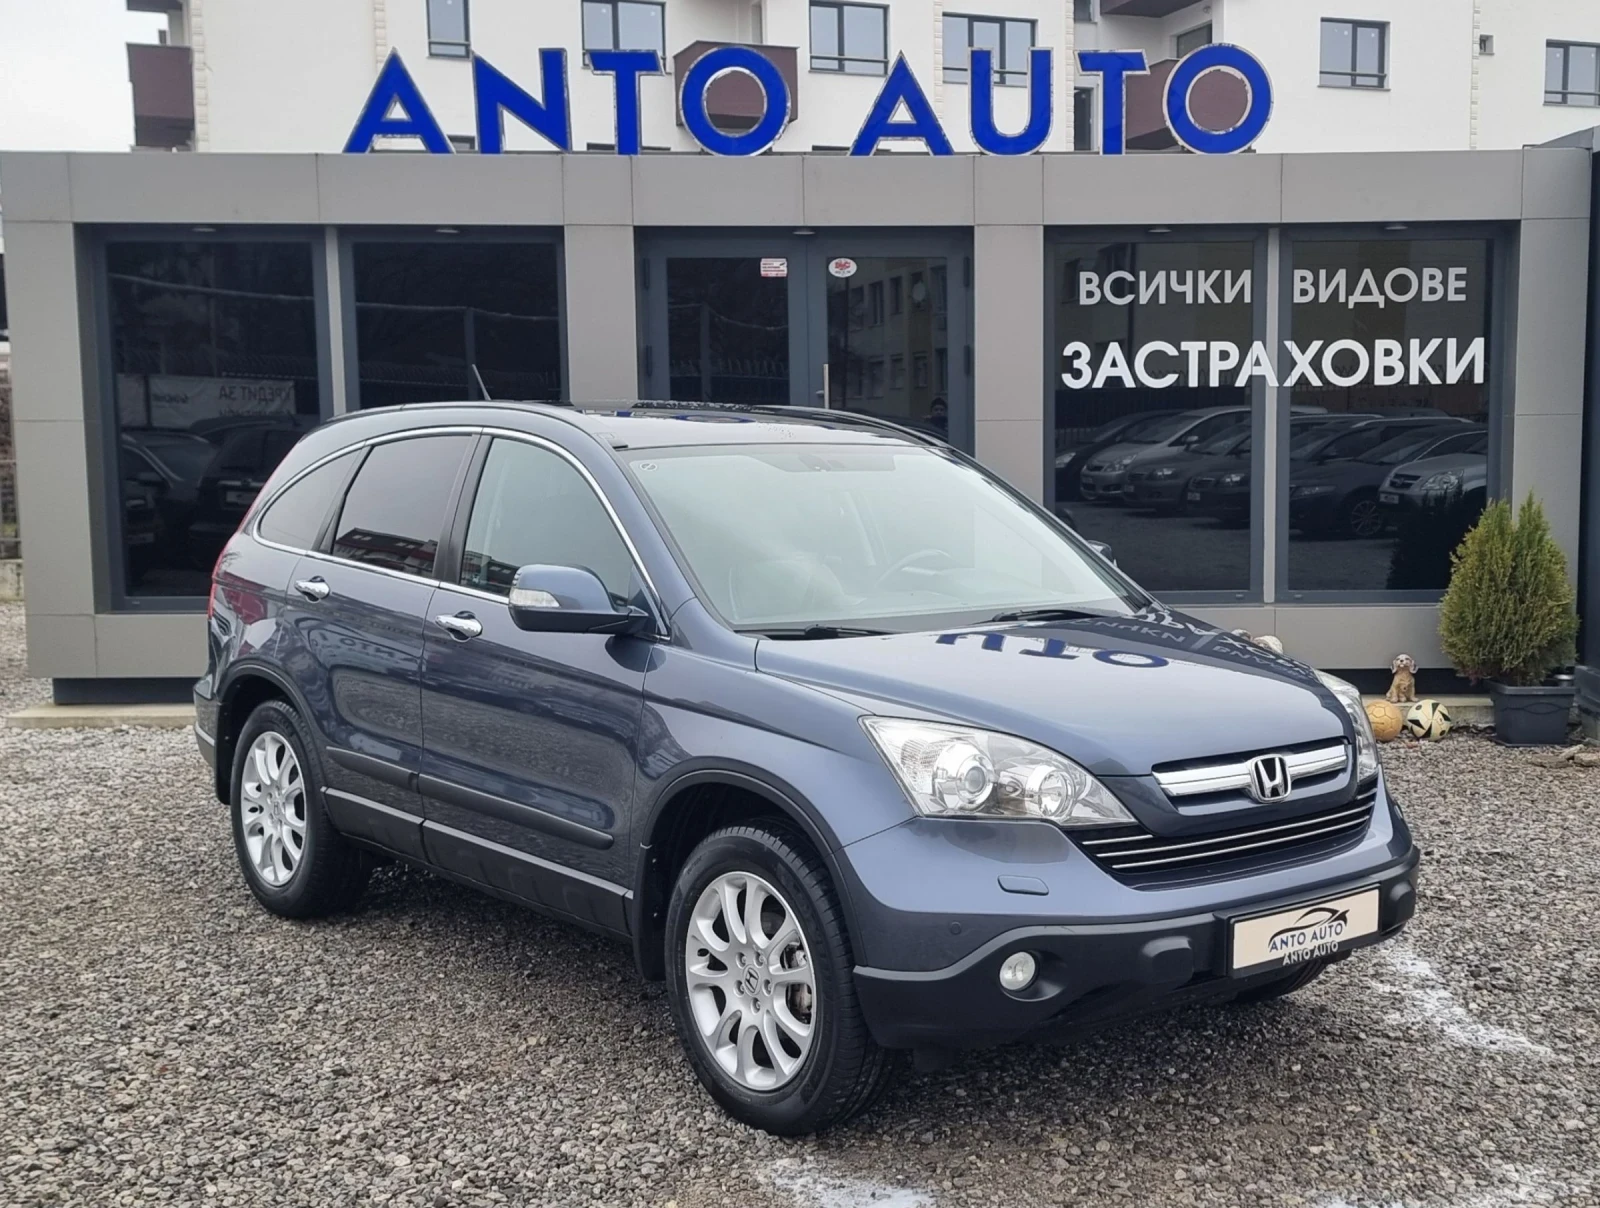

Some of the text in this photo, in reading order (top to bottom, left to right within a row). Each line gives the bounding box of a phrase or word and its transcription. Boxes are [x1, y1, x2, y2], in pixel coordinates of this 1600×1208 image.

[343, 43, 1274, 156] ANTO AUTO
[1079, 267, 1468, 309] ВСИЧКИ ВИДОВЕ
[1061, 336, 1485, 390] ЗАСТРАХОВКИ
[1270, 922, 1344, 952] ANTO AUTO
[1283, 940, 1339, 966] ANTO AUTO
